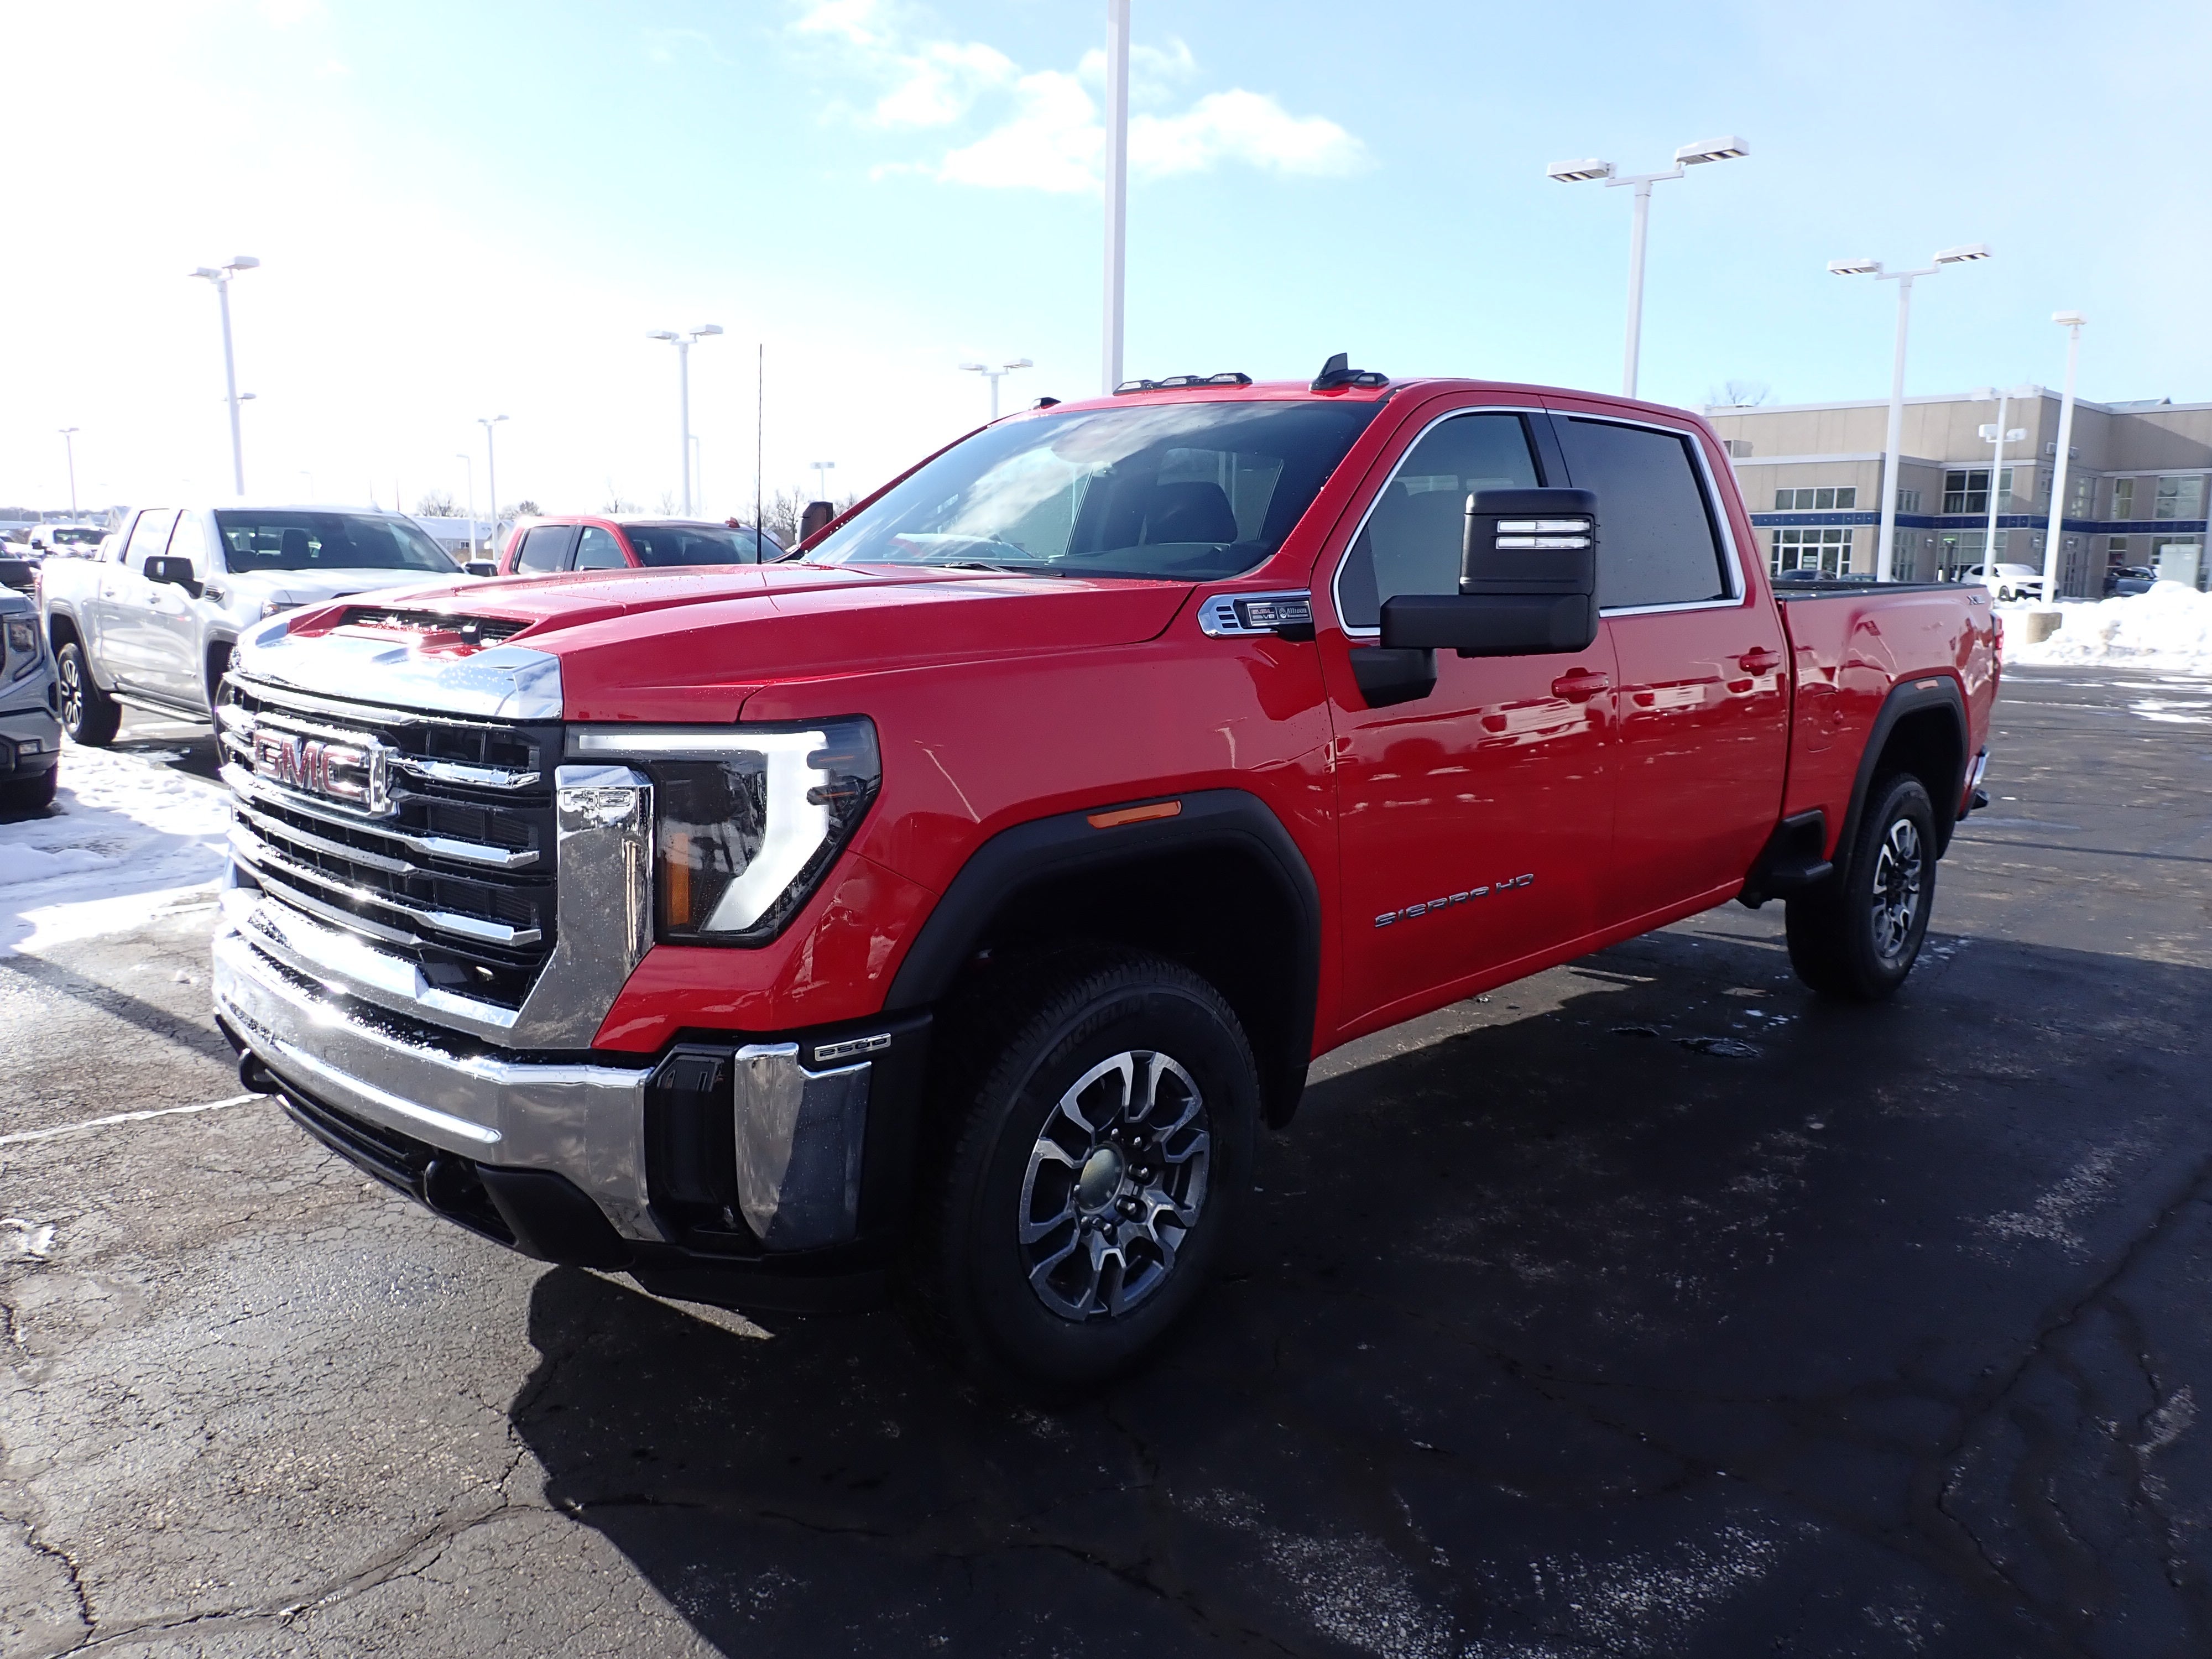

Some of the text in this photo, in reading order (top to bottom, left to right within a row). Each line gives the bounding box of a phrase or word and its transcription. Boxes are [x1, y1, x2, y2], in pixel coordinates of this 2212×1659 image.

[254, 728, 369, 802] GMC
[1375, 873, 1534, 927] SIERRA HD
[819, 1037, 888, 1057] 2500
